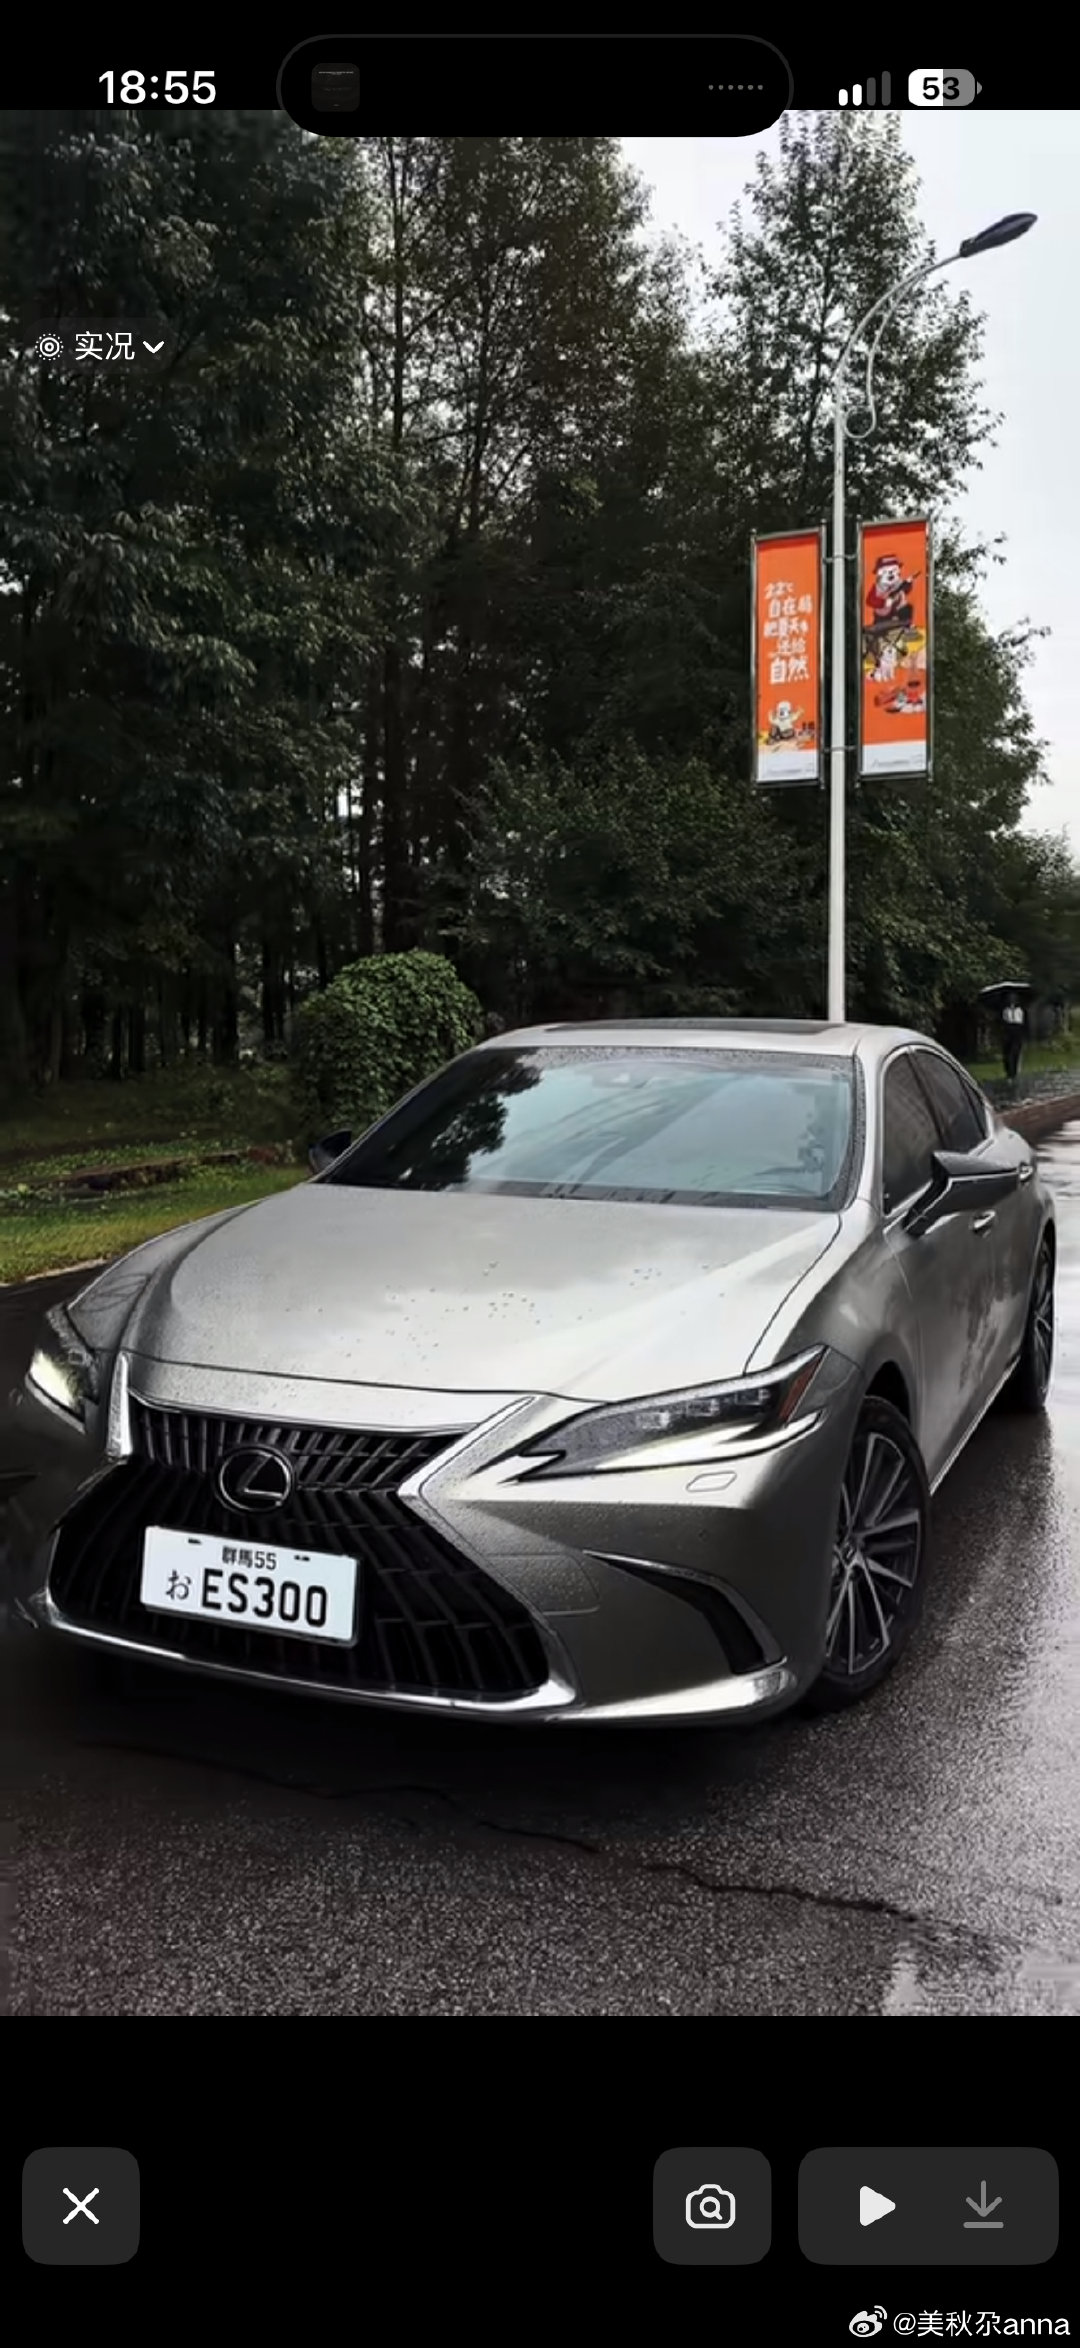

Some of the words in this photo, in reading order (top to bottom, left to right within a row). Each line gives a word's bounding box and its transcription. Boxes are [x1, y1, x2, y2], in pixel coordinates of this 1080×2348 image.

[770, 656, 809, 684] 自然
[166, 1569, 192, 1600] お
[202, 1568, 327, 1627] ES300
